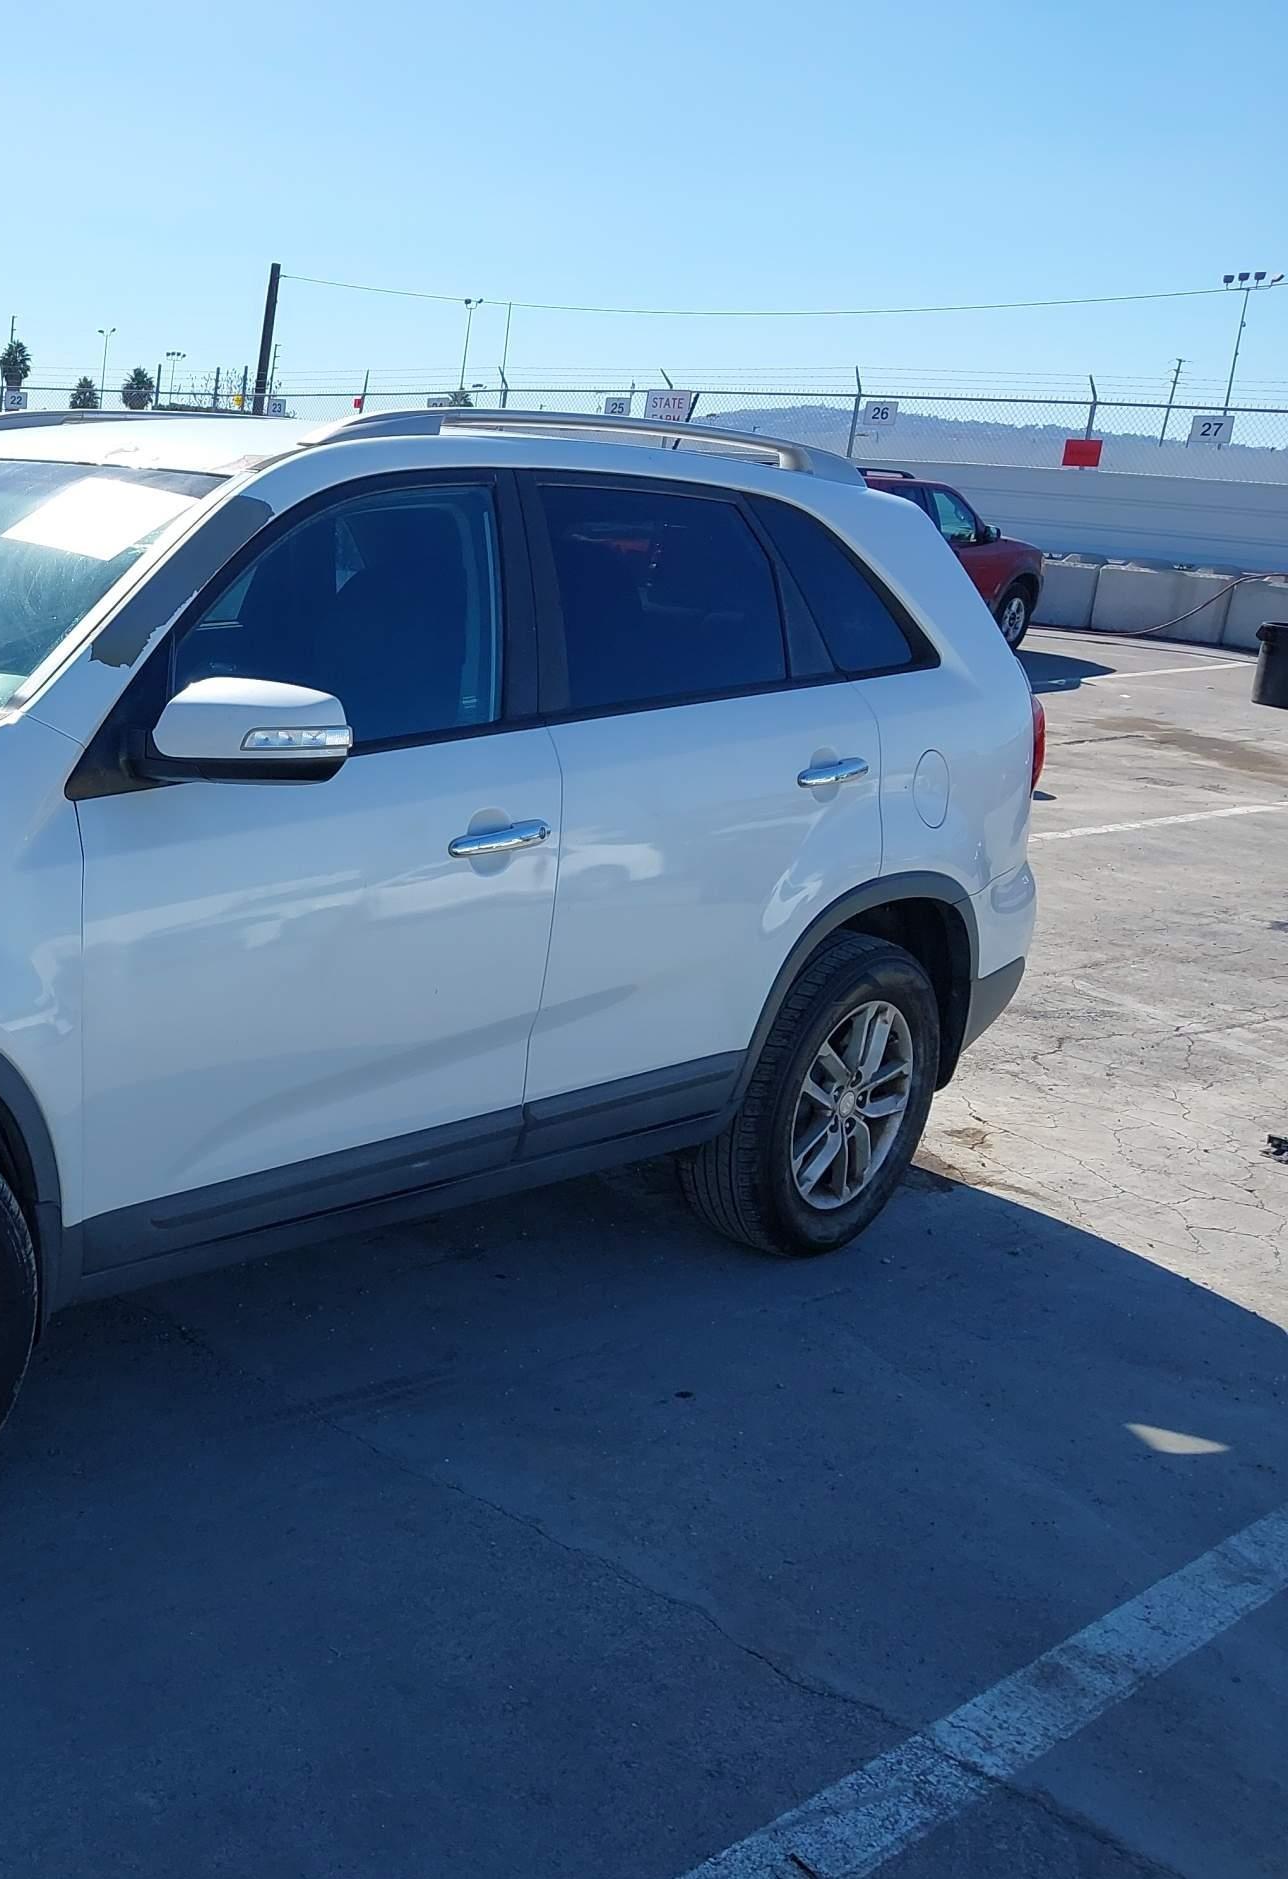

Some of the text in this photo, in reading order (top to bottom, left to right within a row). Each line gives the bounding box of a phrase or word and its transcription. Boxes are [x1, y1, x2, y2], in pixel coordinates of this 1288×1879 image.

[10, 395, 22, 405] 22
[652, 397, 685, 409] STATE
[272, 403, 282, 413] 23
[610, 402, 624, 414] 25
[871, 406, 890, 420] 26
[1199, 422, 1224, 437] 27
